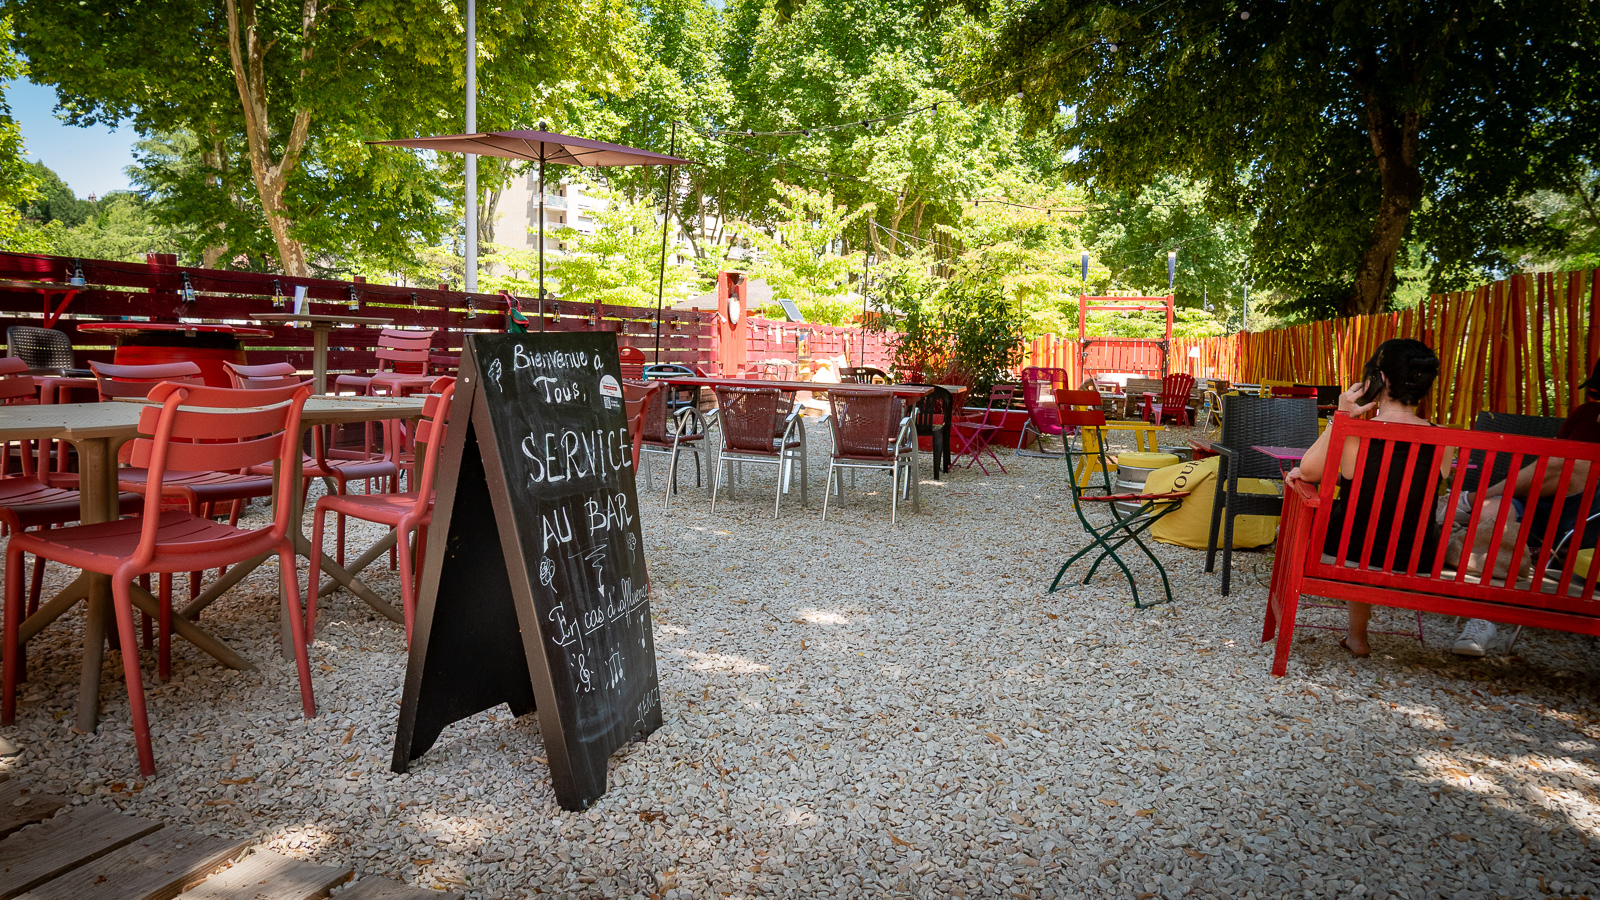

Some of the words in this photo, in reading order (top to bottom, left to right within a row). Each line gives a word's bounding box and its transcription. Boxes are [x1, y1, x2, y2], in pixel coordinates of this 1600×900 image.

[513, 344, 588, 371] Bienvenue
[594, 348, 604, 371] à
[521, 428, 632, 483] SERVICE
[542, 506, 573, 553] AU
[584, 493, 633, 537] BAR
[549, 601, 584, 651] En
[584, 605, 605, 629] cas
